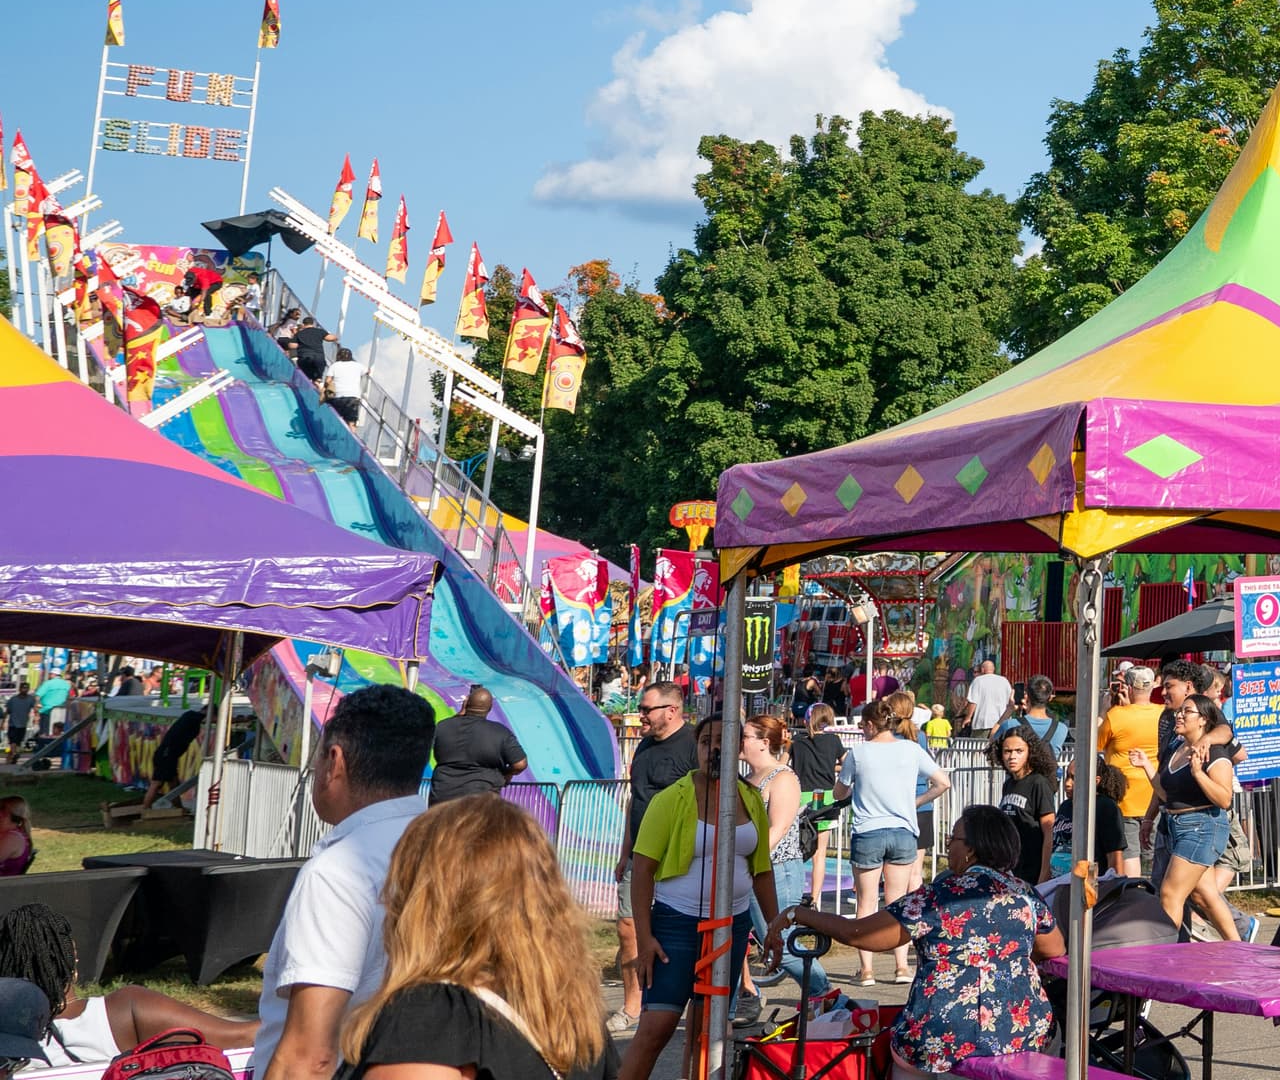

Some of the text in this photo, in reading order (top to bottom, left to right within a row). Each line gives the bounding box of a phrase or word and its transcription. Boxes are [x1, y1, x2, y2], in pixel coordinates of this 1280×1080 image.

[125, 64, 235, 107] FUN
[103, 118, 242, 162] SLIDE
[698, 614, 713, 625] EXIT
[1260, 599, 1274, 621] 9
[1239, 680, 1266, 696] SIZE
[1234, 714, 1259, 729] STATE
[1260, 712, 1277, 727] FAIR
